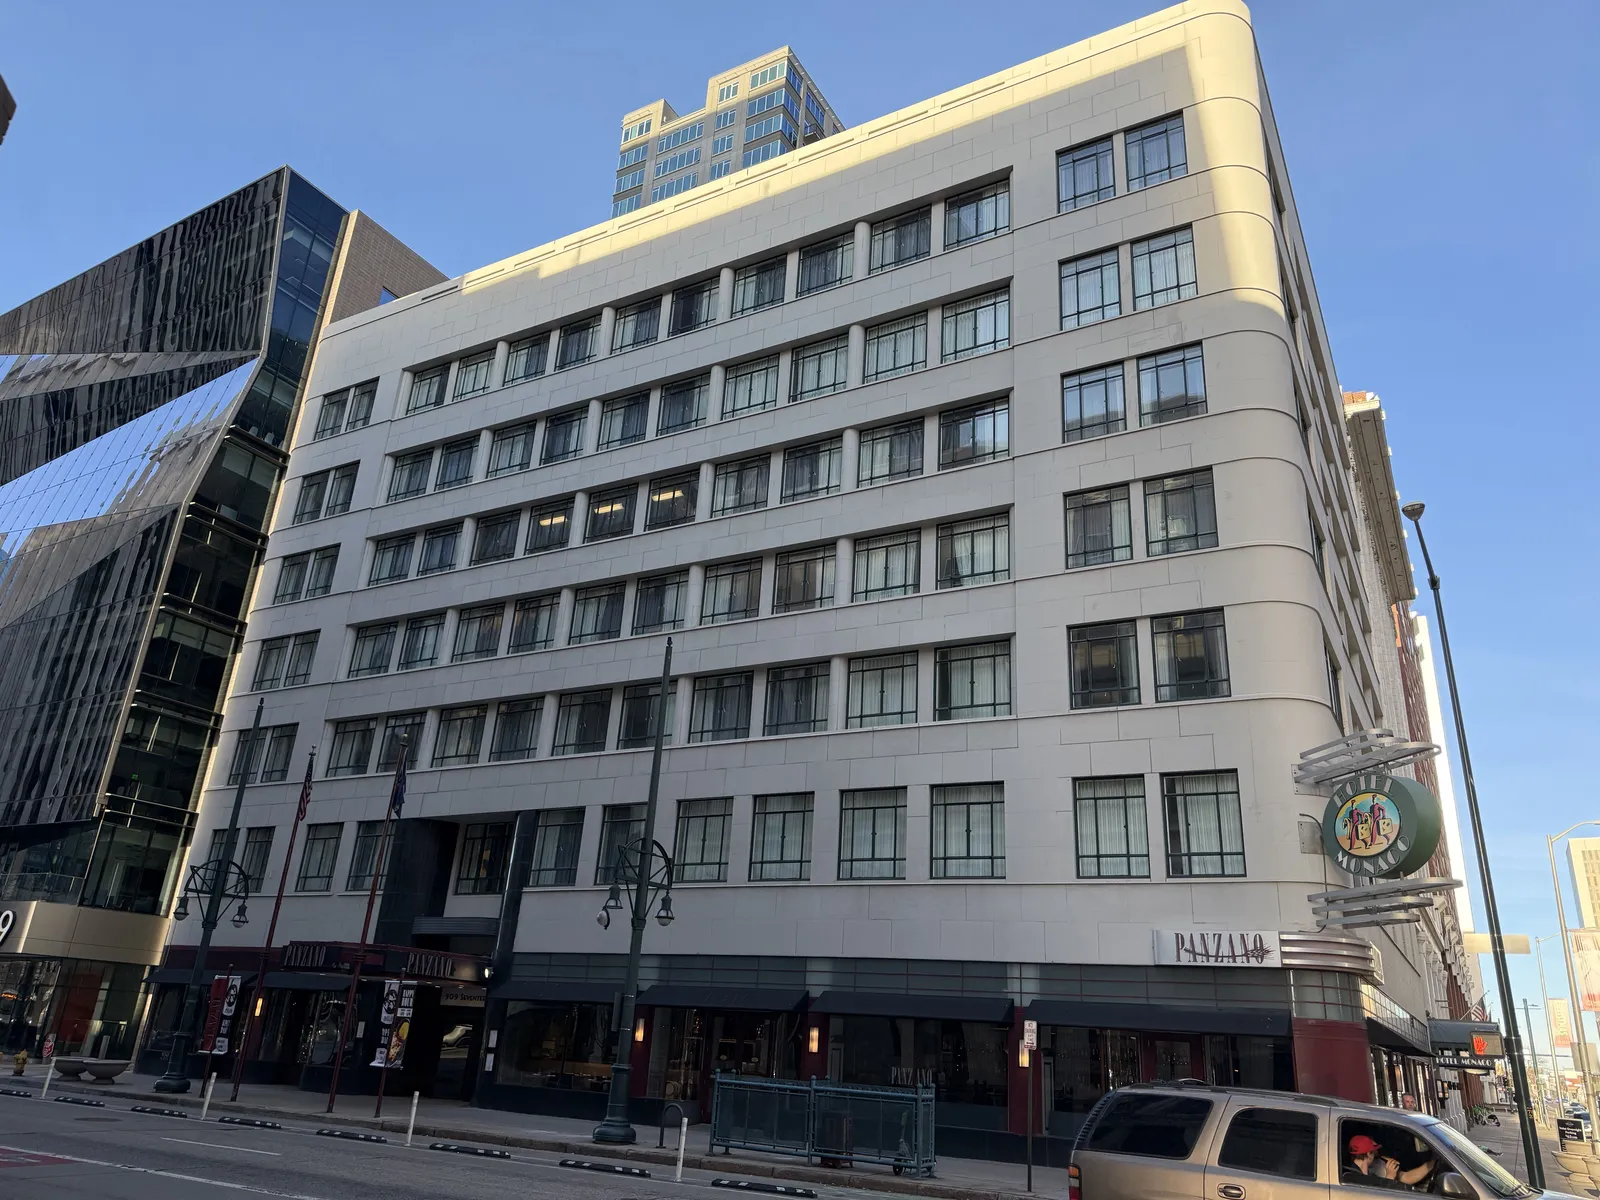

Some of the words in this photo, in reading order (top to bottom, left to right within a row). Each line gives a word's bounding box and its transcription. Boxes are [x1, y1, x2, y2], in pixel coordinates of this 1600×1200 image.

[1333, 774, 1394, 809] HOTEL
[1334, 834, 1411, 876] MONACO
[284, 945, 327, 968] PANZANO
[1173, 931, 1266, 965] PANZANO
[406, 952, 453, 978] PANZANO
[444, 992, 459, 1001] 909
[1435, 1057, 1459, 1065] HOTEL
[1461, 1058, 1492, 1067] MONACO
